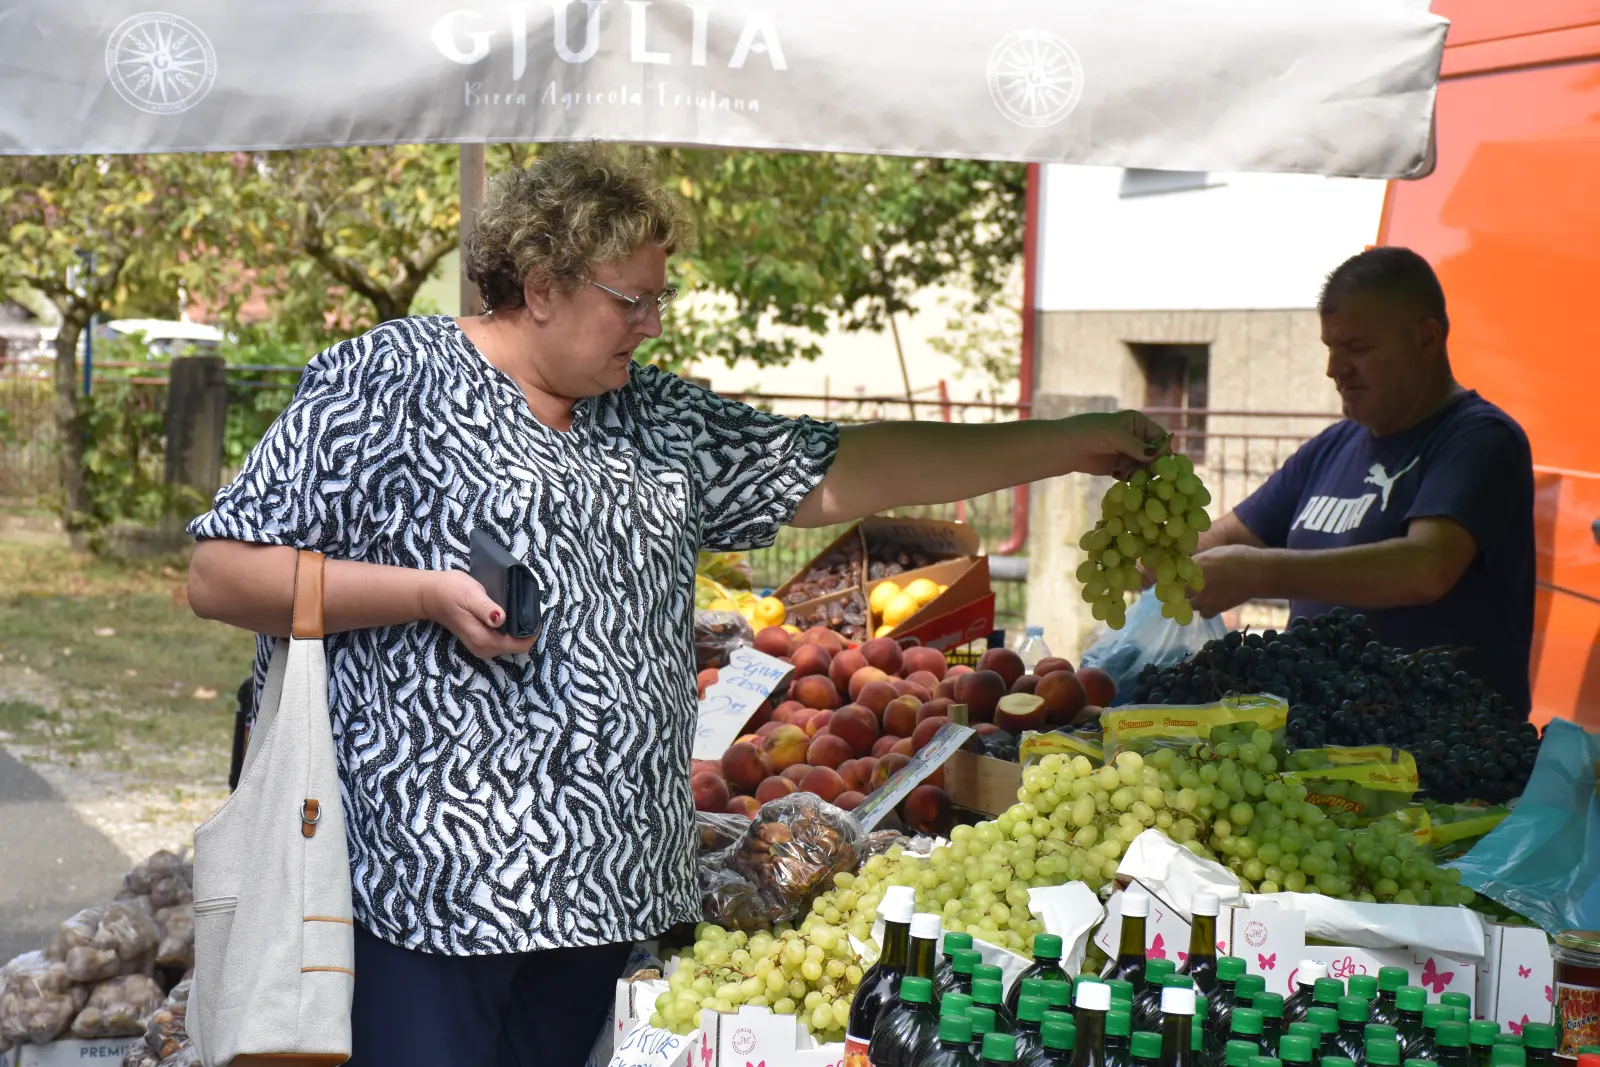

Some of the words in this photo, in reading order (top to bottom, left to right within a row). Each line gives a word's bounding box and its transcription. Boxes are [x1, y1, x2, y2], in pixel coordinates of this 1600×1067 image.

[464, 80, 526, 107] Birra
[540, 80, 643, 112] Agricola
[657, 82, 760, 112] Friulana
[1291, 493, 1377, 534] PUMA
